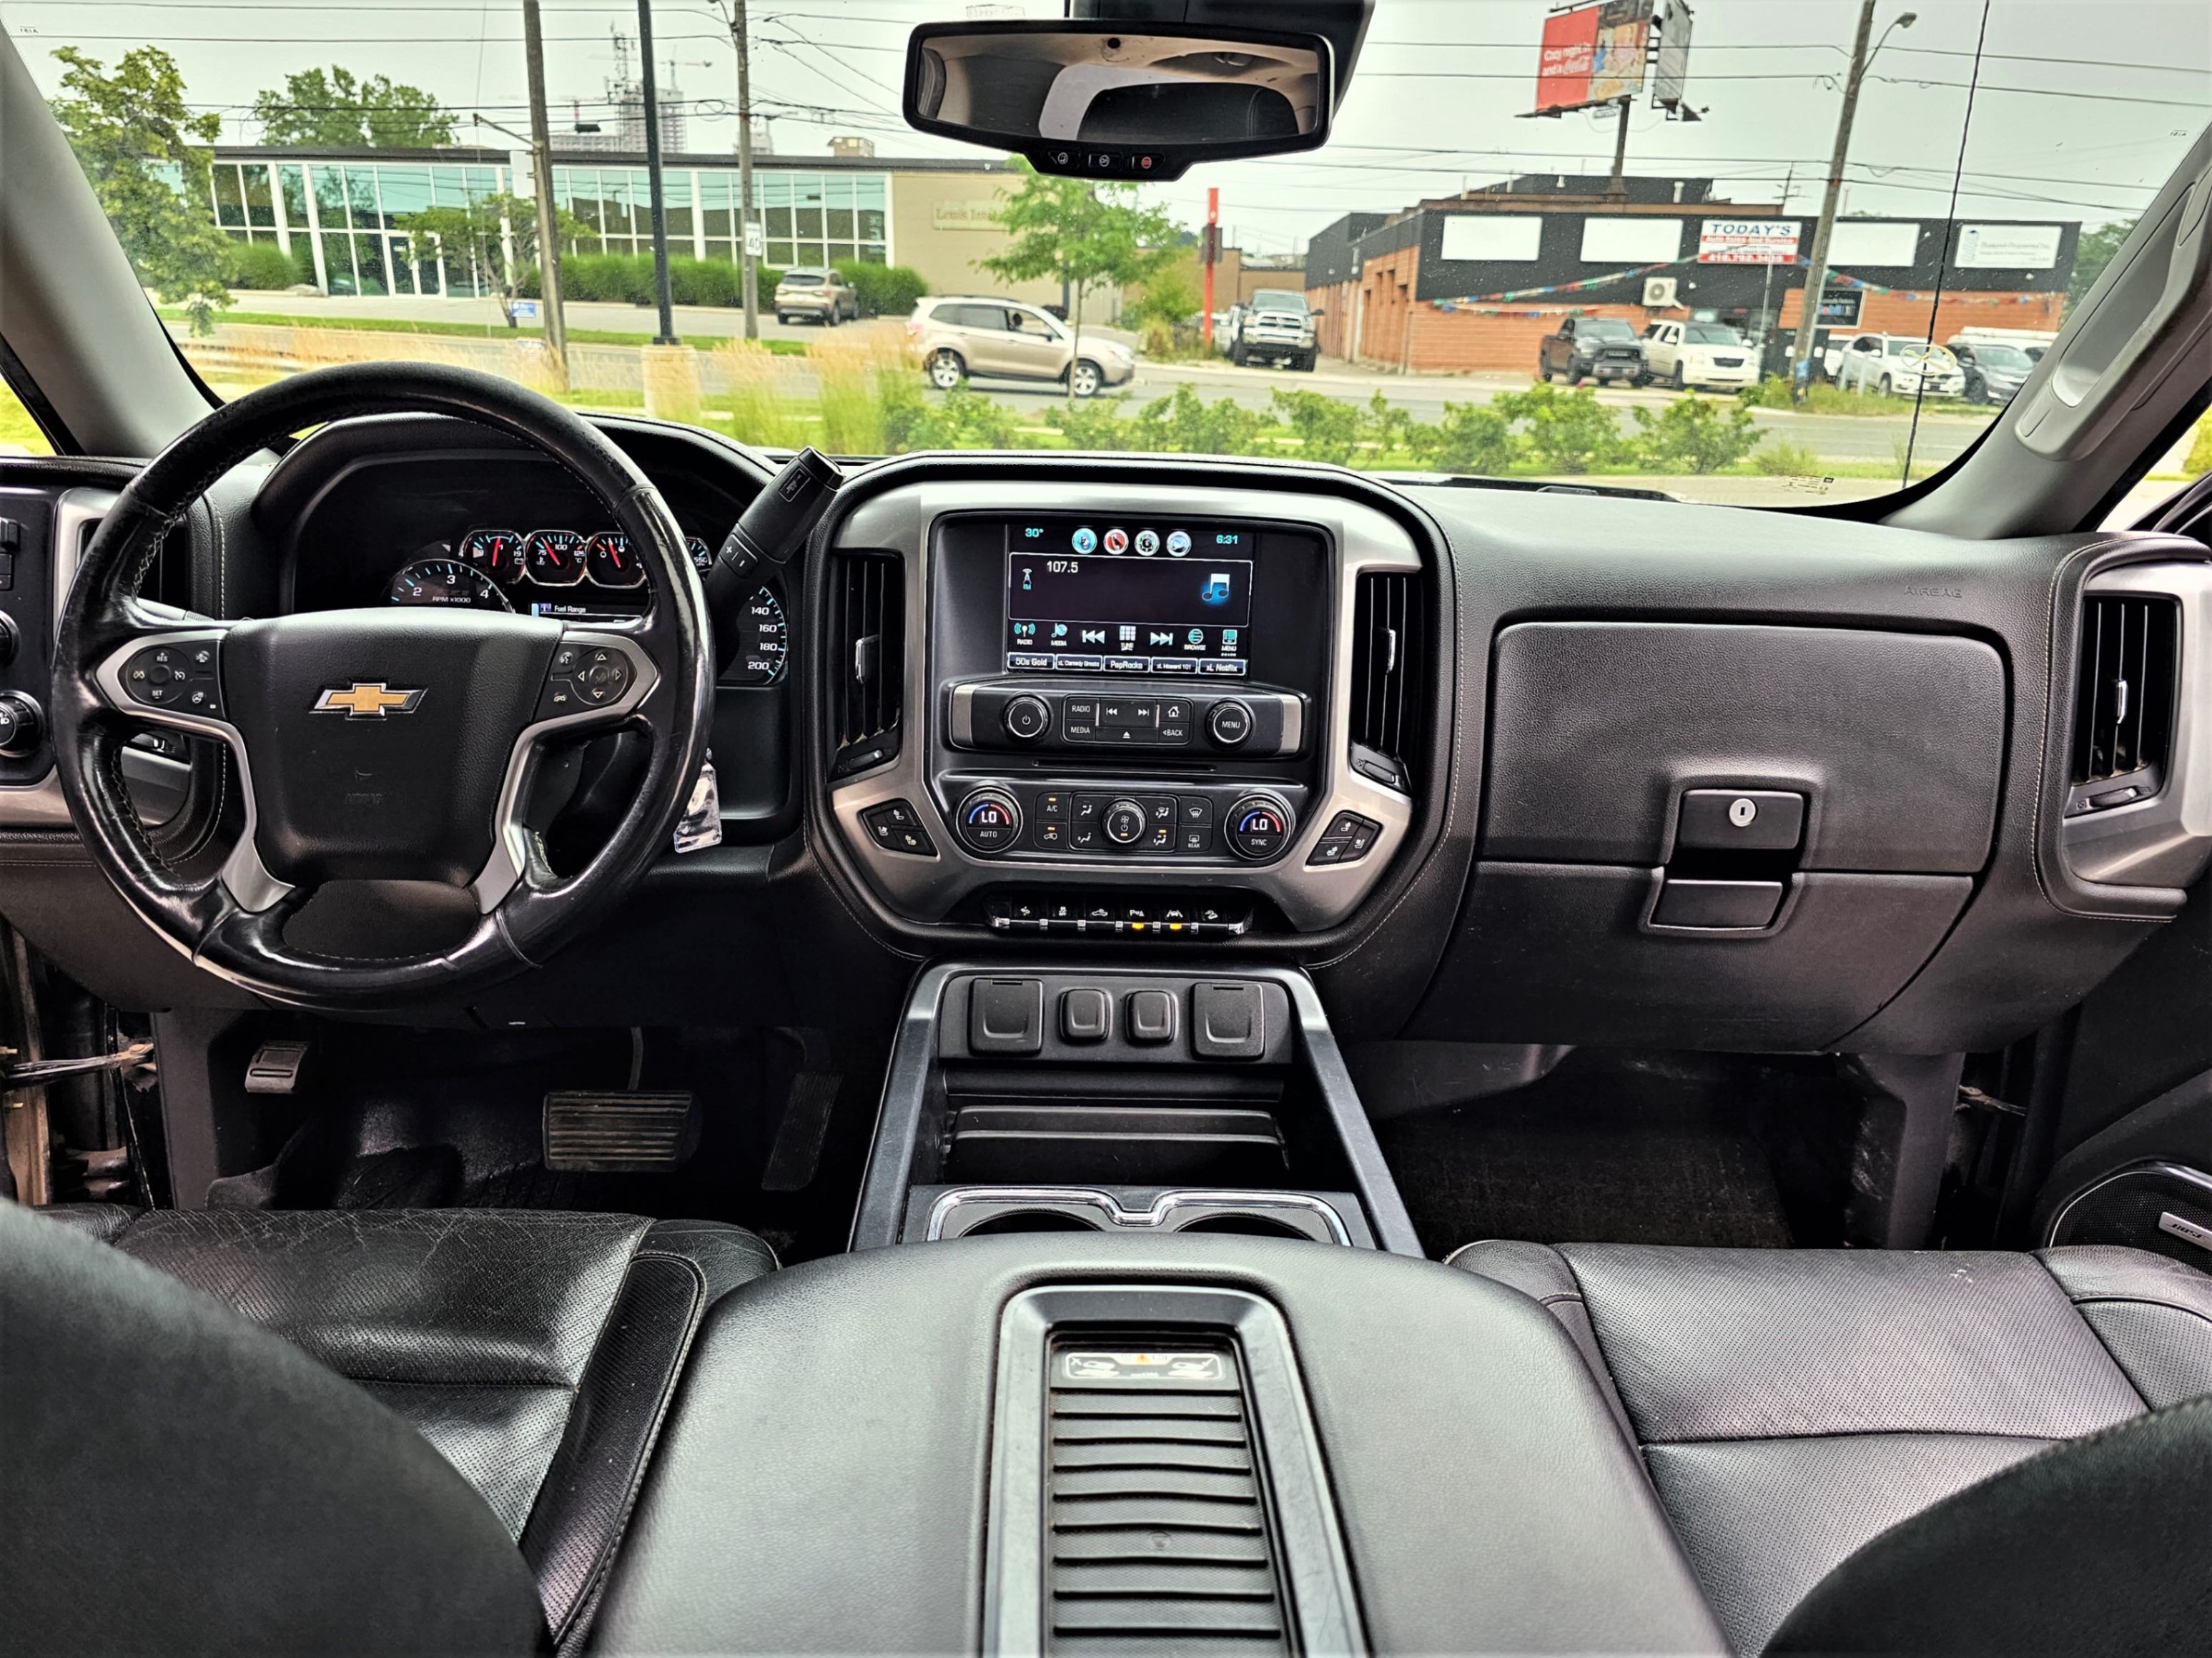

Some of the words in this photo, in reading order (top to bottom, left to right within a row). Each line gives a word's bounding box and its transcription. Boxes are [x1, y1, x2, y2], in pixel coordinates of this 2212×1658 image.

[1712, 224, 1791, 235] TODAY'S
[1216, 535, 1238, 544] 6:31
[1047, 561, 1079, 573] 107.5
[446, 574, 456, 584] 3
[413, 586, 423, 596] 2
[480, 588, 490, 598] 4
[1903, 585, 1962, 598] AIRBAG
[567, 606, 586, 615] Range
[751, 607, 769, 616] 140
[759, 624, 777, 633] 160
[759, 642, 778, 651] 180
[747, 661, 769, 671] 200
[1015, 657, 1030, 666] 50s
[1031, 658, 1047, 666] Gold
[1110, 660, 1143, 670] PopRocks
[1070, 726, 1090, 734] MEDIA
[1221, 721, 1240, 729] MENU
[981, 811, 997, 823] LO
[1253, 818, 1268, 831] LO
